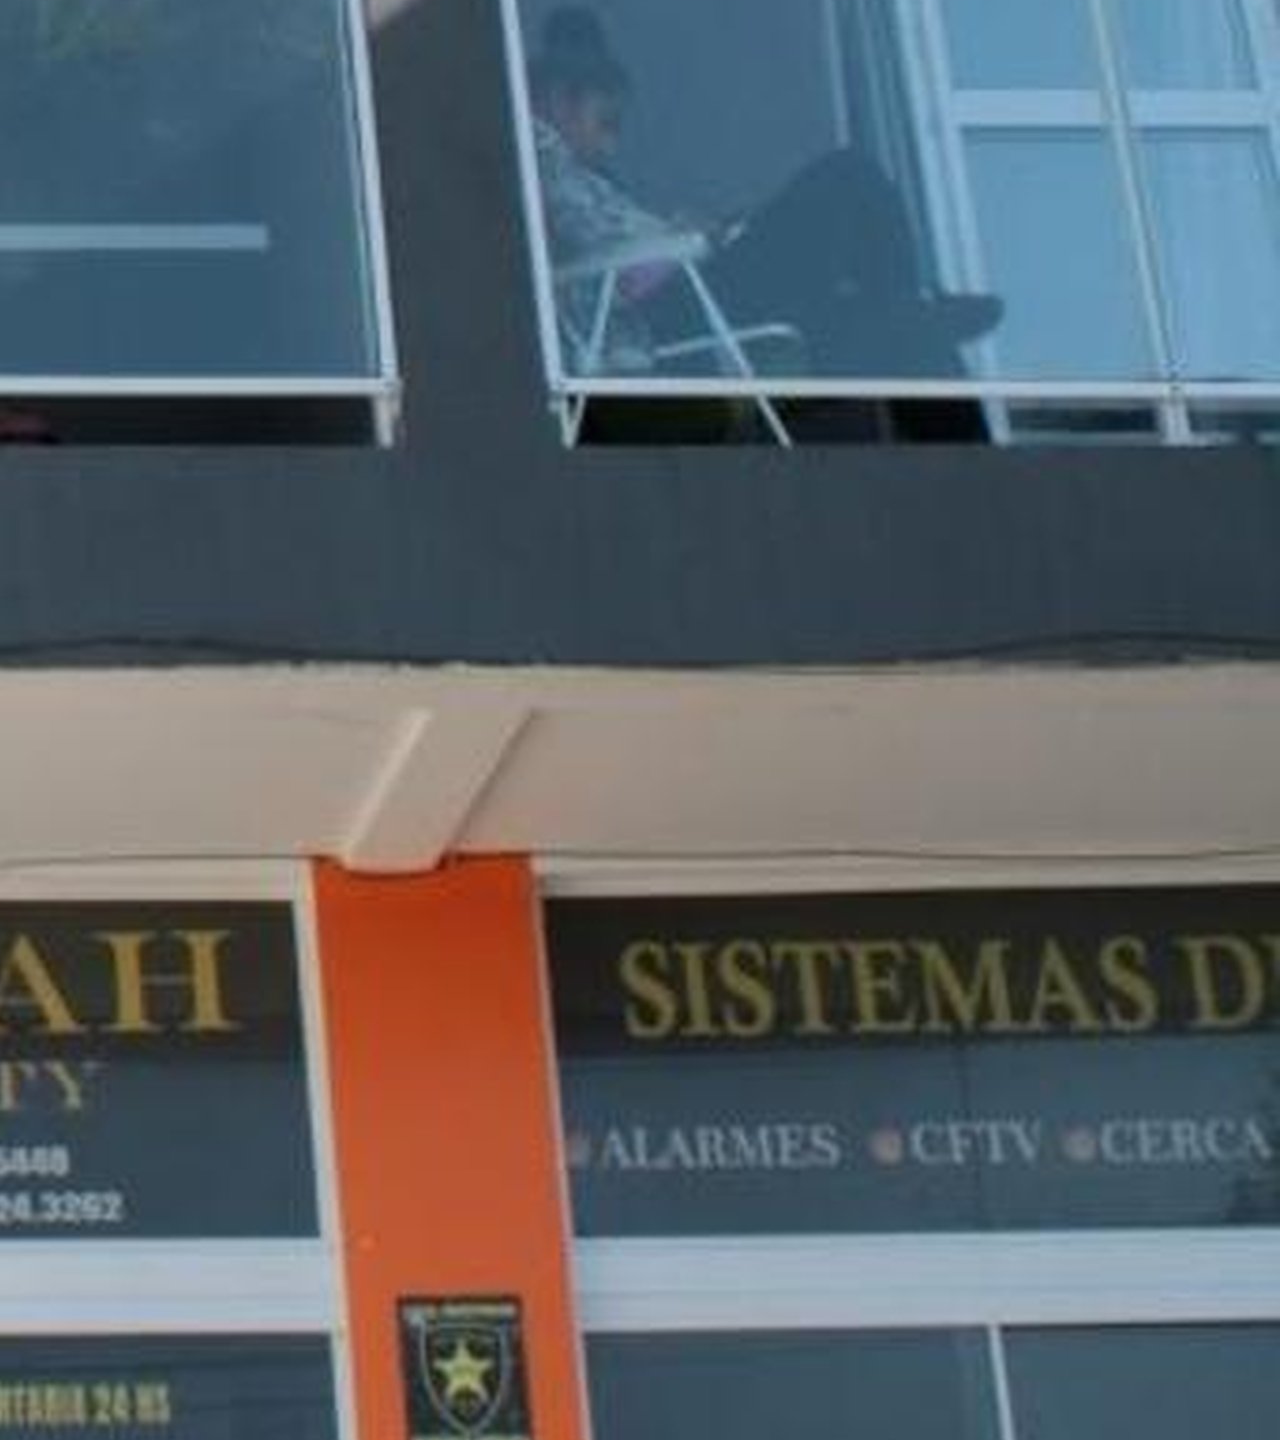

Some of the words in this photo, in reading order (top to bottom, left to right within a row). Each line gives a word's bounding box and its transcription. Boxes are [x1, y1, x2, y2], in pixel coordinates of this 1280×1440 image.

[618, 935, 1158, 1036] SISTEMAS
[1172, 931, 1280, 1029] D
[598, 1125, 841, 1168] ALARMES
[911, 1121, 1042, 1164] CFTV
[1100, 1118, 1274, 1164] CERCA
[92, 1384, 128, 1423] 24
